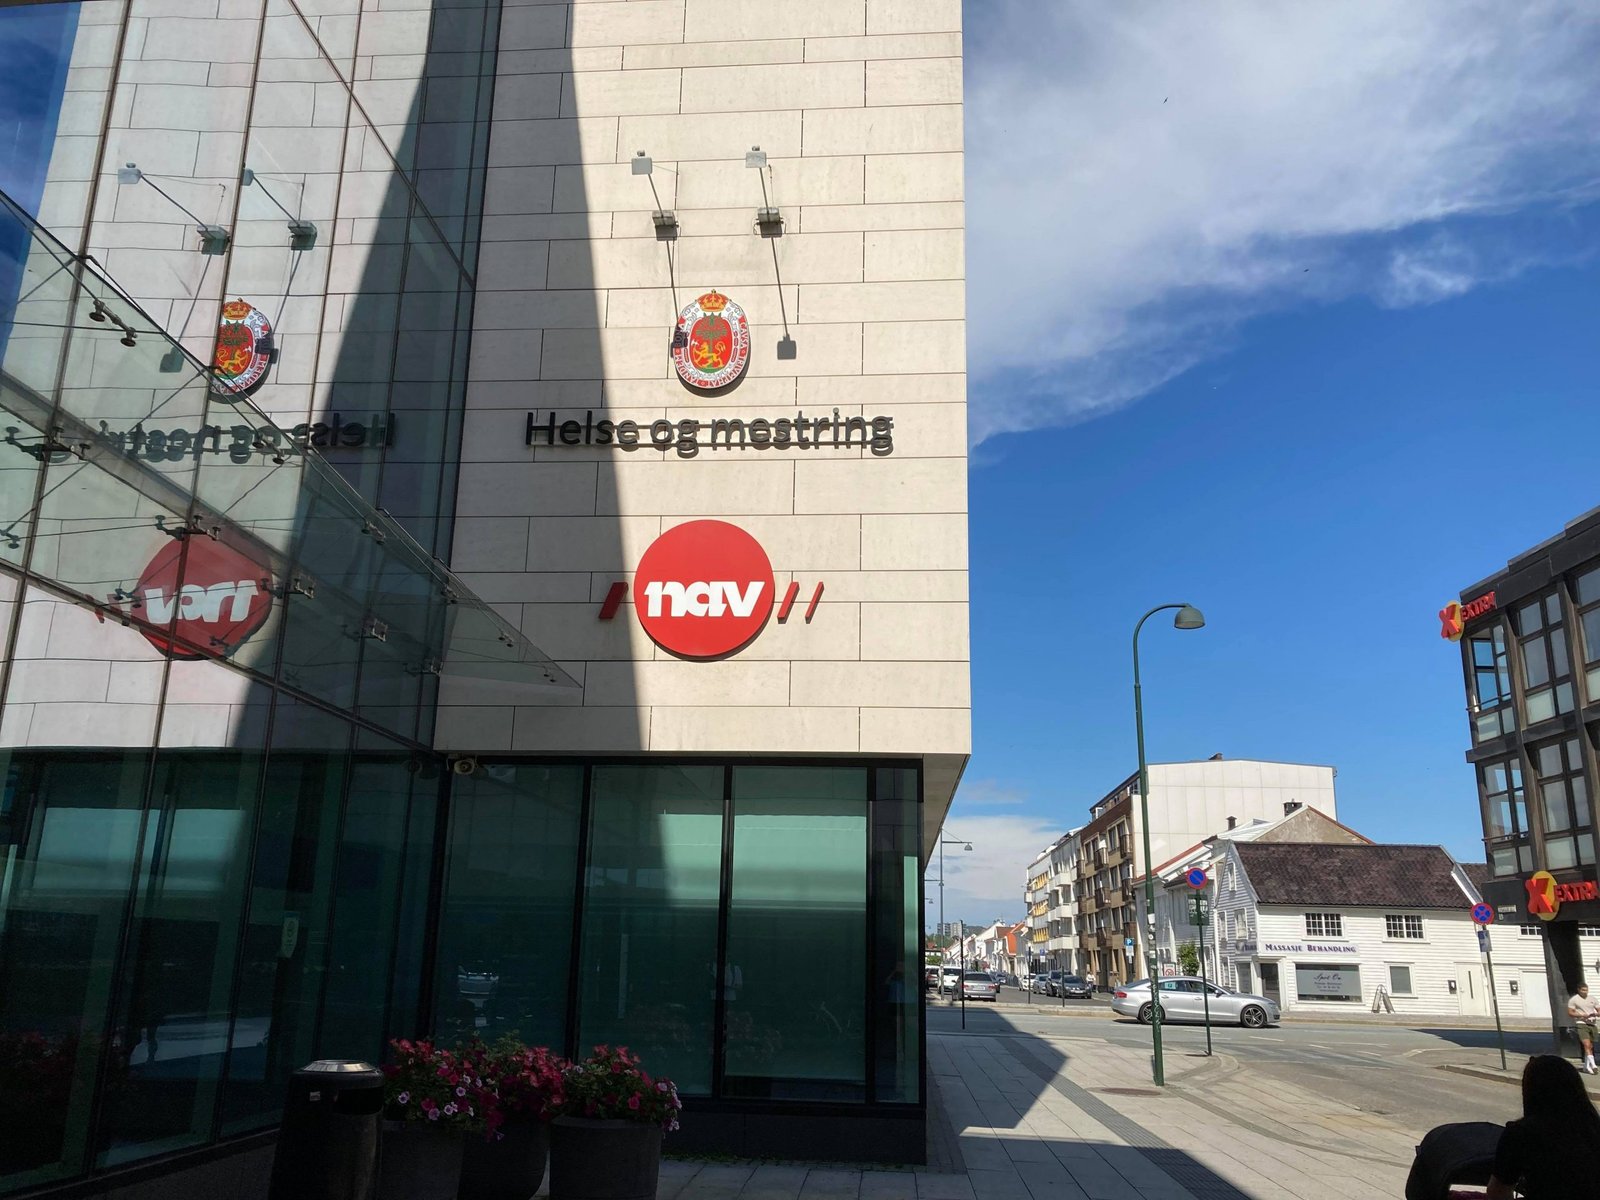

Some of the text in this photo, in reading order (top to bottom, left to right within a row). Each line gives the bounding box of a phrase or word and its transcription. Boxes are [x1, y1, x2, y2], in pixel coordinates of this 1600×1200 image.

[739, 322, 748, 348] CAVSA
[675, 356, 698, 385] TANDEM
[525, 407, 894, 454] Helse og mestring
[644, 581, 765, 618] nav
[1460, 591, 1497, 622] EXTRA
[1553, 880, 1600, 903] EXTRA
[1307, 944, 1357, 953] BEHANDLING
